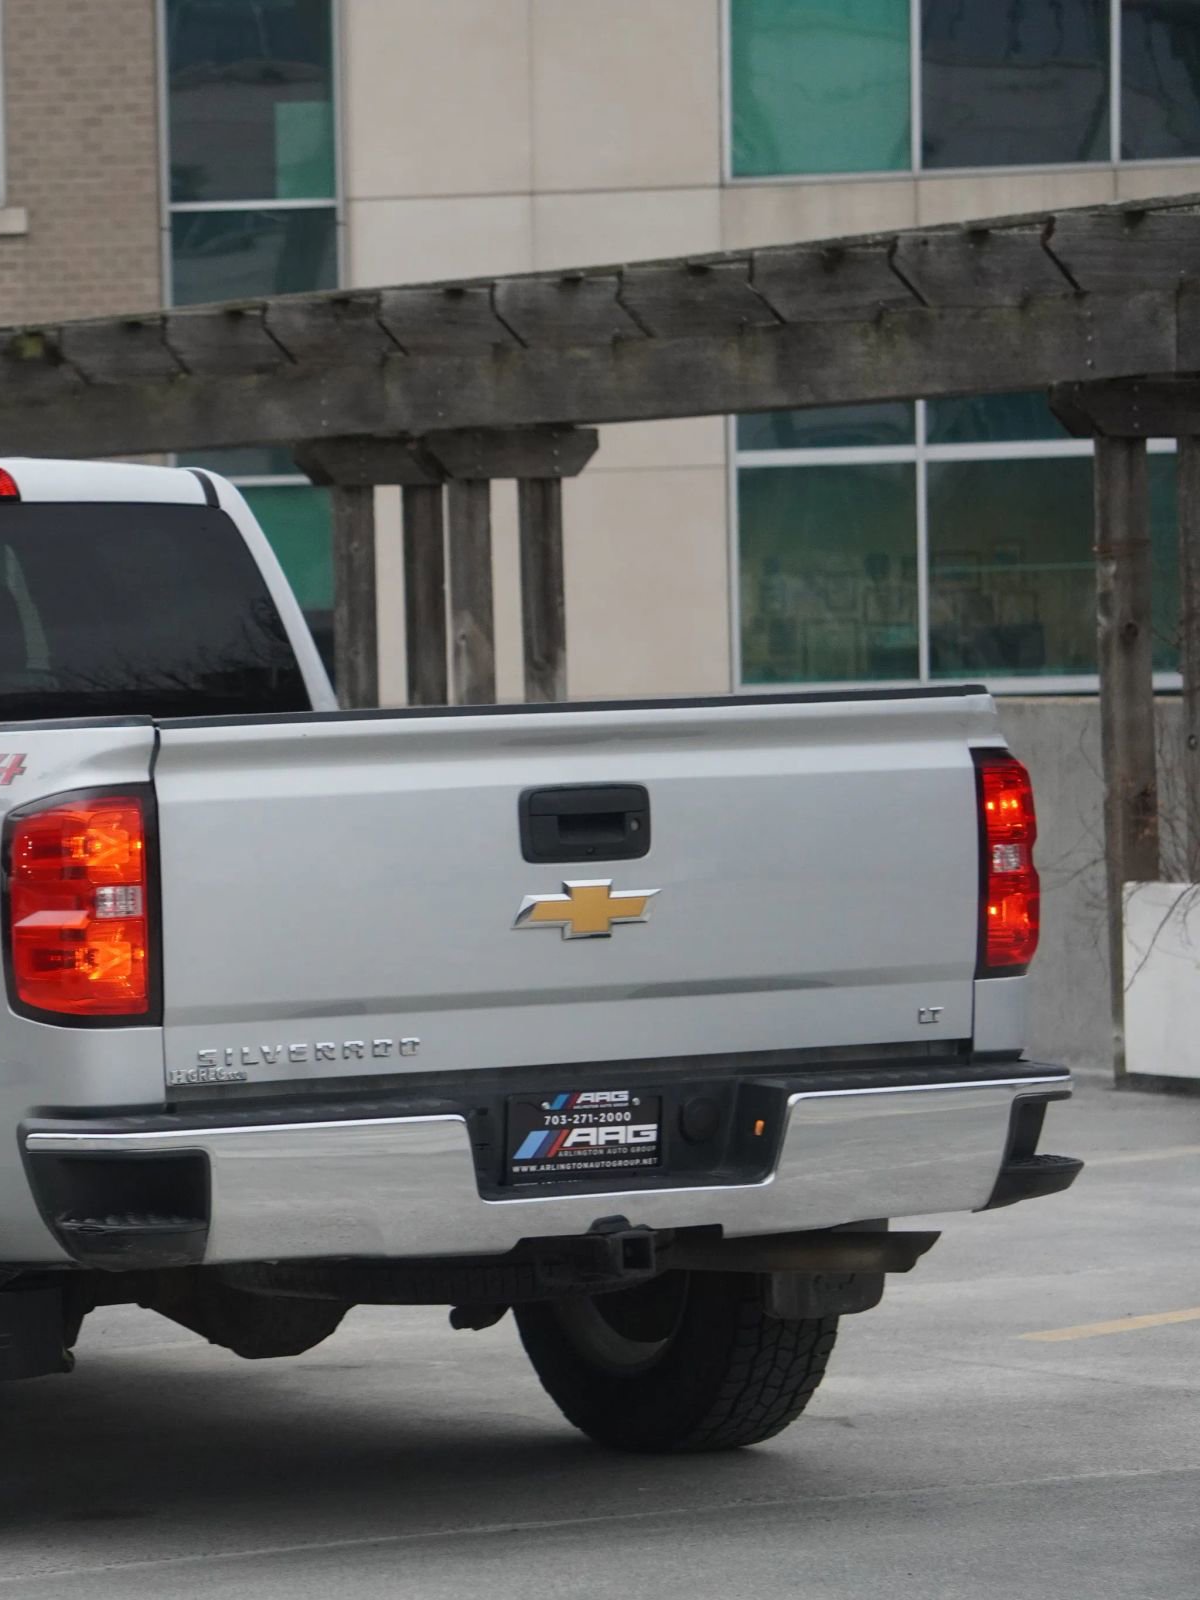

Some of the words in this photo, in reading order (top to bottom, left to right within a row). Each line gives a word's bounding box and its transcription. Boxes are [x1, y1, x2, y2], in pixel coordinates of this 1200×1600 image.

[918, 1007, 944, 1024] LT
[197, 1037, 420, 1067] SILVERADO
[576, 1090, 629, 1104] AAG
[544, 1111, 631, 1125] 703-271-2000
[563, 1124, 658, 1147] AAG
[558, 1149, 604, 1157] ARLINGTON
[606, 1147, 628, 1155] AUTO
[630, 1145, 656, 1153] GROUP
[512, 1157, 658, 1172] WWW.ARLINGTONAUTOGROUP.NET
